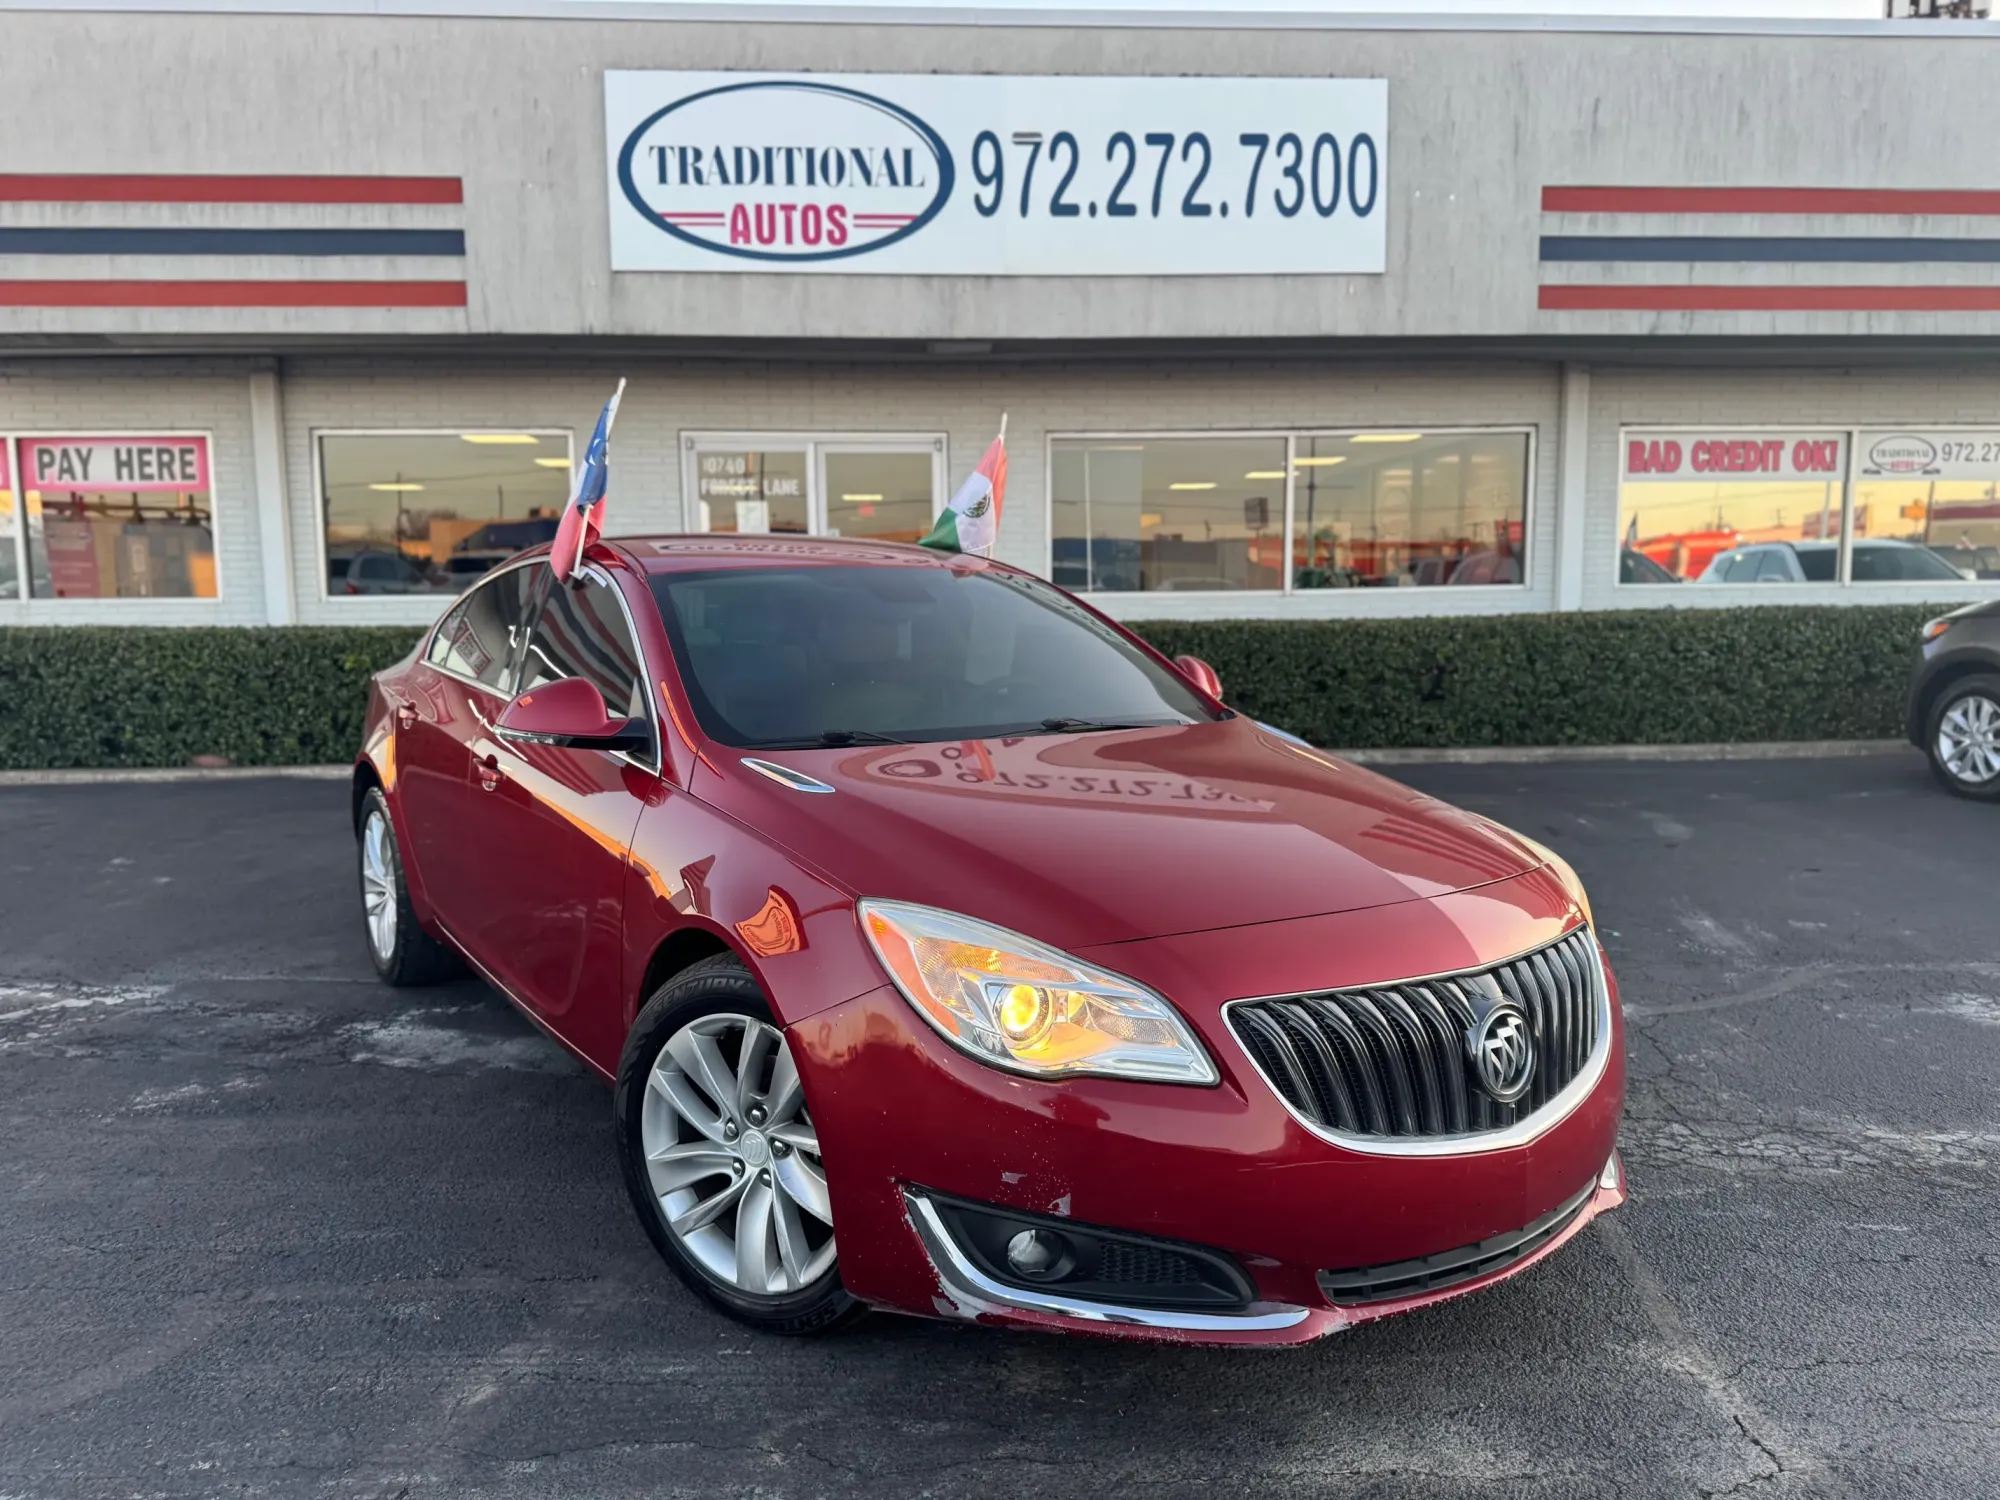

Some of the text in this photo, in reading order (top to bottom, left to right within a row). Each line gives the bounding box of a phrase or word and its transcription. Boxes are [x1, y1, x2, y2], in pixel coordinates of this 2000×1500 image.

[648, 144, 926, 189] TRADITIONAL
[971, 129, 1379, 219] 972.272.7300
[729, 203, 848, 247] AUTOS
[36, 446, 197, 482] PAY HERE
[1628, 439, 1839, 473] BAD CREDIT OK!
[763, 478, 800, 496] LANE
